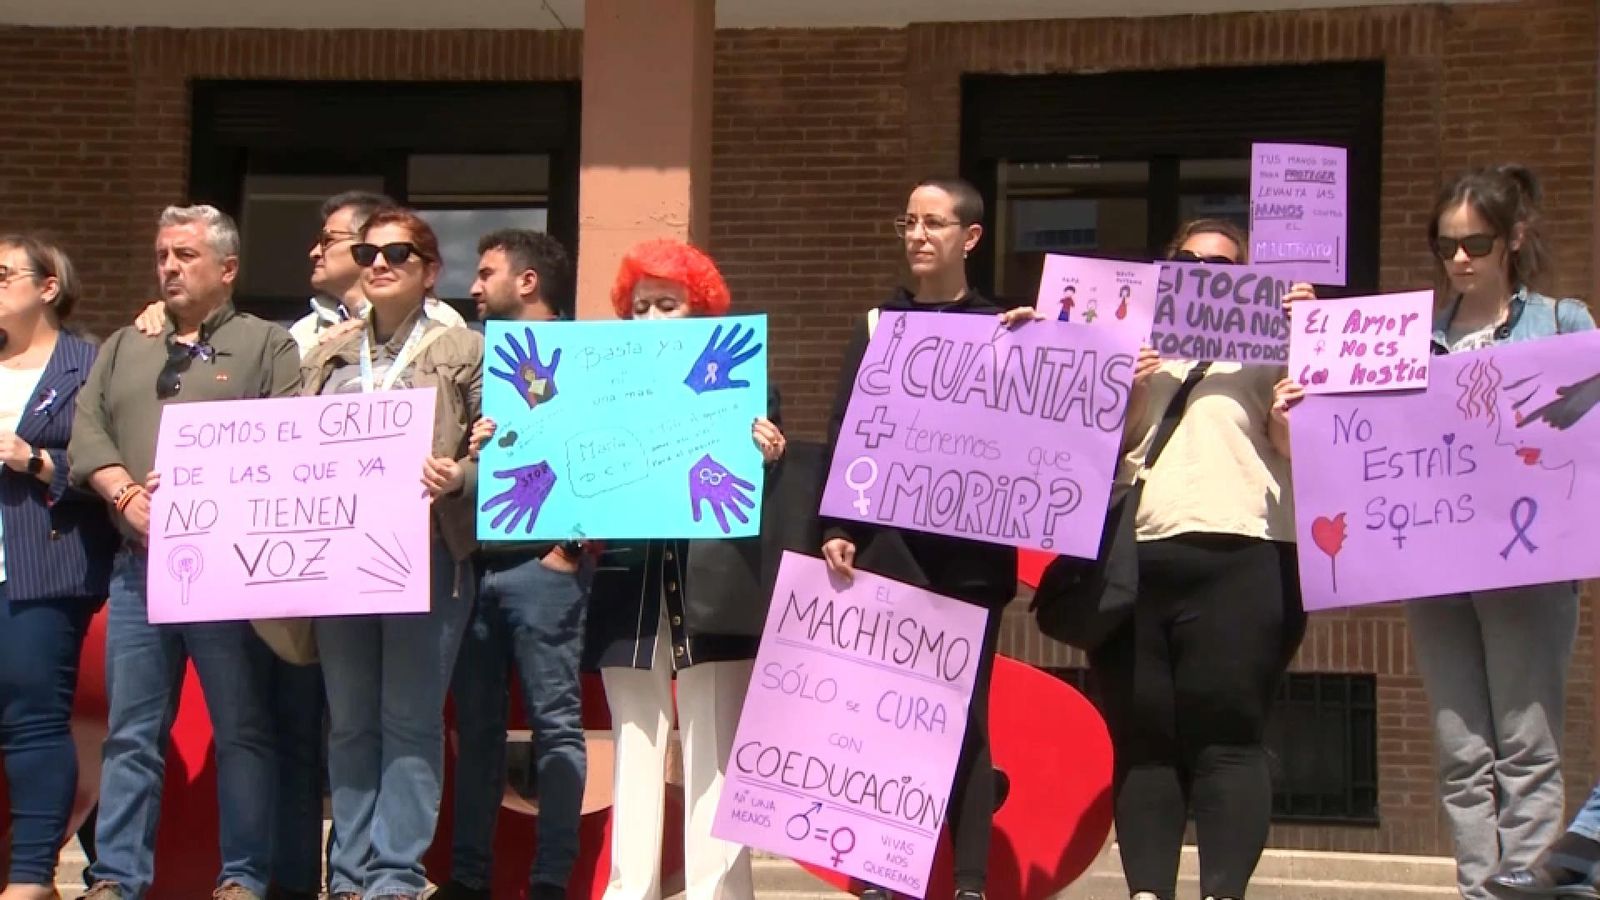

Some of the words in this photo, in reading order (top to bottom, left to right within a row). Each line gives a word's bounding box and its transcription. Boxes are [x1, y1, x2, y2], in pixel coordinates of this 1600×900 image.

[1260, 154, 1281, 165] TUS
[1284, 169, 1336, 182] PROTEGER
[1258, 186, 1307, 198] LEVANTA
[1316, 190, 1336, 199] LAS
[1285, 223, 1302, 231] EL
[1188, 268, 1293, 310] TOCAN
[1153, 294, 1176, 327] A
[1186, 301, 1246, 335] UNA
[1250, 311, 1292, 341] NOS
[1152, 331, 1222, 359] TOCAN
[175, 421, 267, 448] SOMOS
[277, 421, 303, 443] EL
[318, 400, 413, 437] GRITO
[1333, 407, 1373, 446] NO
[905, 408, 1001, 460] tenemos
[1028, 446, 1073, 481] que
[173, 466, 204, 486] DE
[229, 465, 271, 484] LAS
[292, 461, 338, 484] QUE
[358, 456, 386, 478] YA
[522, 462, 549, 487] STOP
[165, 499, 219, 532] NO
[247, 493, 358, 528] TIENEN
[1365, 494, 1475, 549] SOLAS
[233, 538, 331, 577] VOZ
[875, 585, 894, 606] EL
[761, 661, 838, 704] SÓLO
[876, 689, 948, 734] CURA
[828, 732, 863, 754] CON
[731, 807, 772, 828] MENOS
[751, 798, 776, 813] UNA
[886, 852, 909, 868] NOS
[863, 860, 921, 890] QUEREMOS
